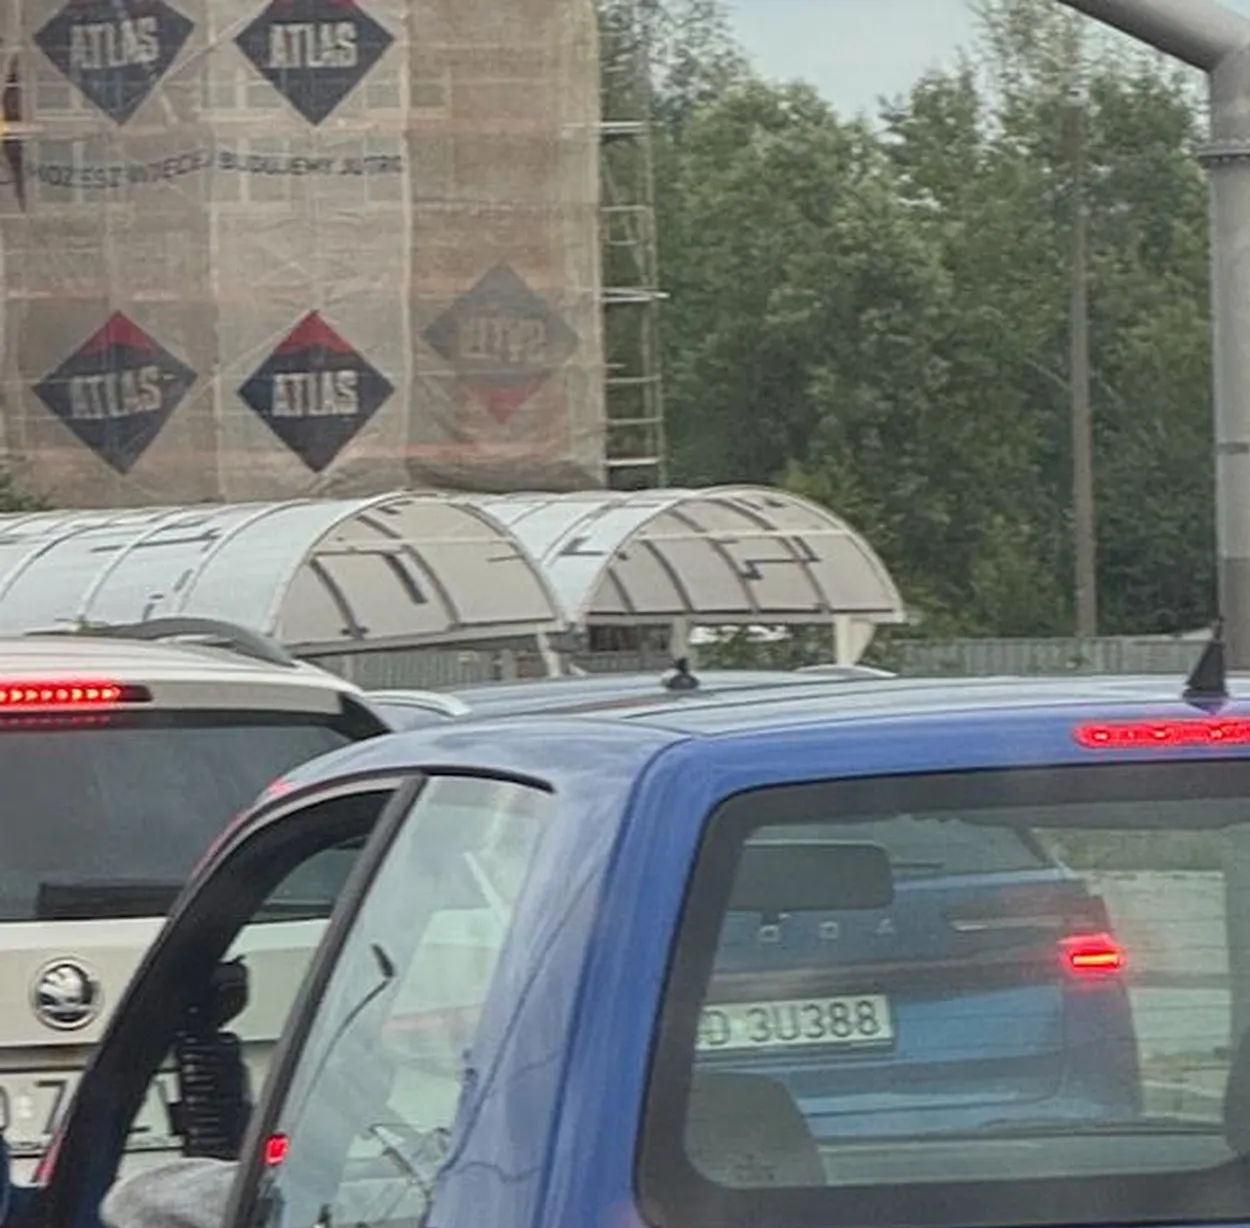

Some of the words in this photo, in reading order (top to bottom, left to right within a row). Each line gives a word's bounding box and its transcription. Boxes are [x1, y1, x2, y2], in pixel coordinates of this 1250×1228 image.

[70, 17, 159, 70] ATLAS
[269, 21, 358, 69] ATLAS
[71, 365, 162, 420] ATLAS
[272, 369, 360, 417] ATLAS
[746, 1000, 880, 1043] 3U388
